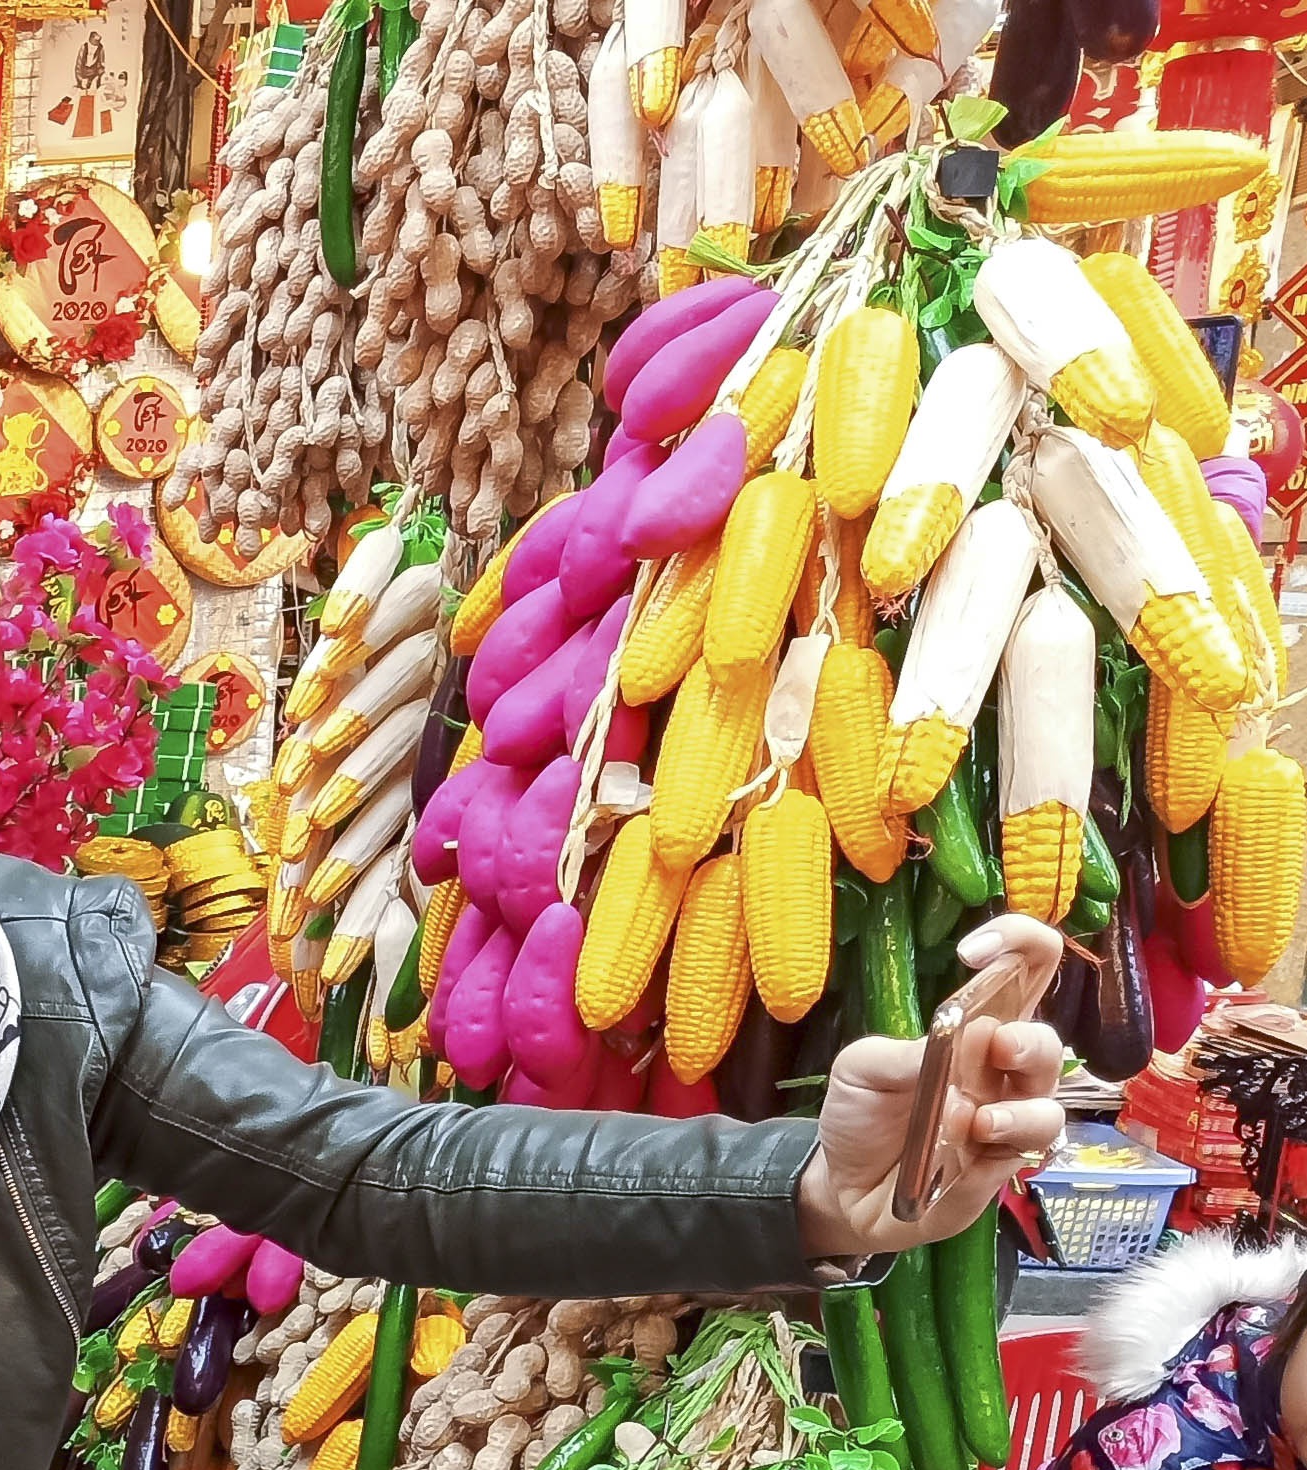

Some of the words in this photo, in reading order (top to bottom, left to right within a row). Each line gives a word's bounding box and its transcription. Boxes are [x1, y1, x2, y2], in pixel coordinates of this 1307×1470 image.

[52, 216, 119, 296] Tết
[52, 301, 108, 321] 2020
[133, 391, 168, 433] Tết
[126, 437, 168, 454] 2020
